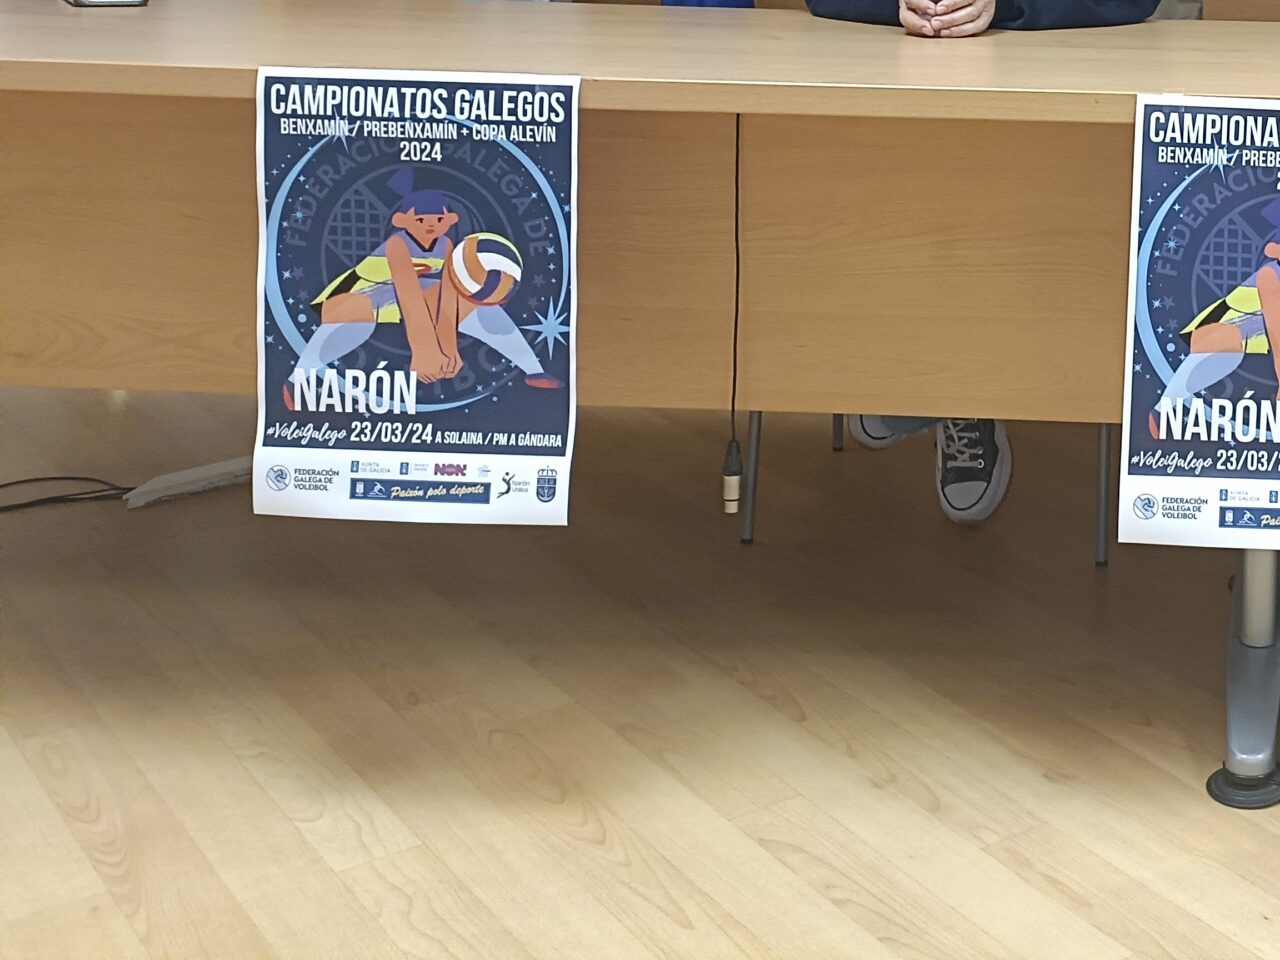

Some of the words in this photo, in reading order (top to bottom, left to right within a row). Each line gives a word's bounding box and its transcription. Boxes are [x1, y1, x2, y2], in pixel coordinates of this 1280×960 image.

[270, 83, 448, 119] CAMPIONATOS
[454, 88, 566, 123] GALEGOS
[280, 117, 349, 136] BENXAMÍN
[363, 120, 458, 140] PREBENXAMÍN
[472, 124, 507, 141] COPA
[509, 123, 557, 143] ALEVÍN
[400, 141, 442, 162] 2024
[1158, 146, 1227, 165] BENXAMÍN
[294, 360, 417, 415] NARÓN
[266, 421, 347, 446] #VoleiGalego
[350, 421, 433, 444] 23/03/24
[435, 431, 442, 443] A
[444, 431, 483, 445] SOLAINA
[493, 432, 508, 446] PM
[509, 433, 516, 446] A
[518, 432, 562, 447] GÁNDARA
[1130, 449, 1213, 475] #VoleiGalego
[294, 468, 339, 477] FEDERACIÓN
[324, 476, 334, 484] DE
[294, 483, 328, 491] VOLEIBOL
[1161, 496, 1208, 505] FEDERACIÓN
[1161, 504, 1191, 512] GALEGA
[1192, 505, 1202, 513] DE
[1161, 512, 1198, 520] VOLEIBOL
